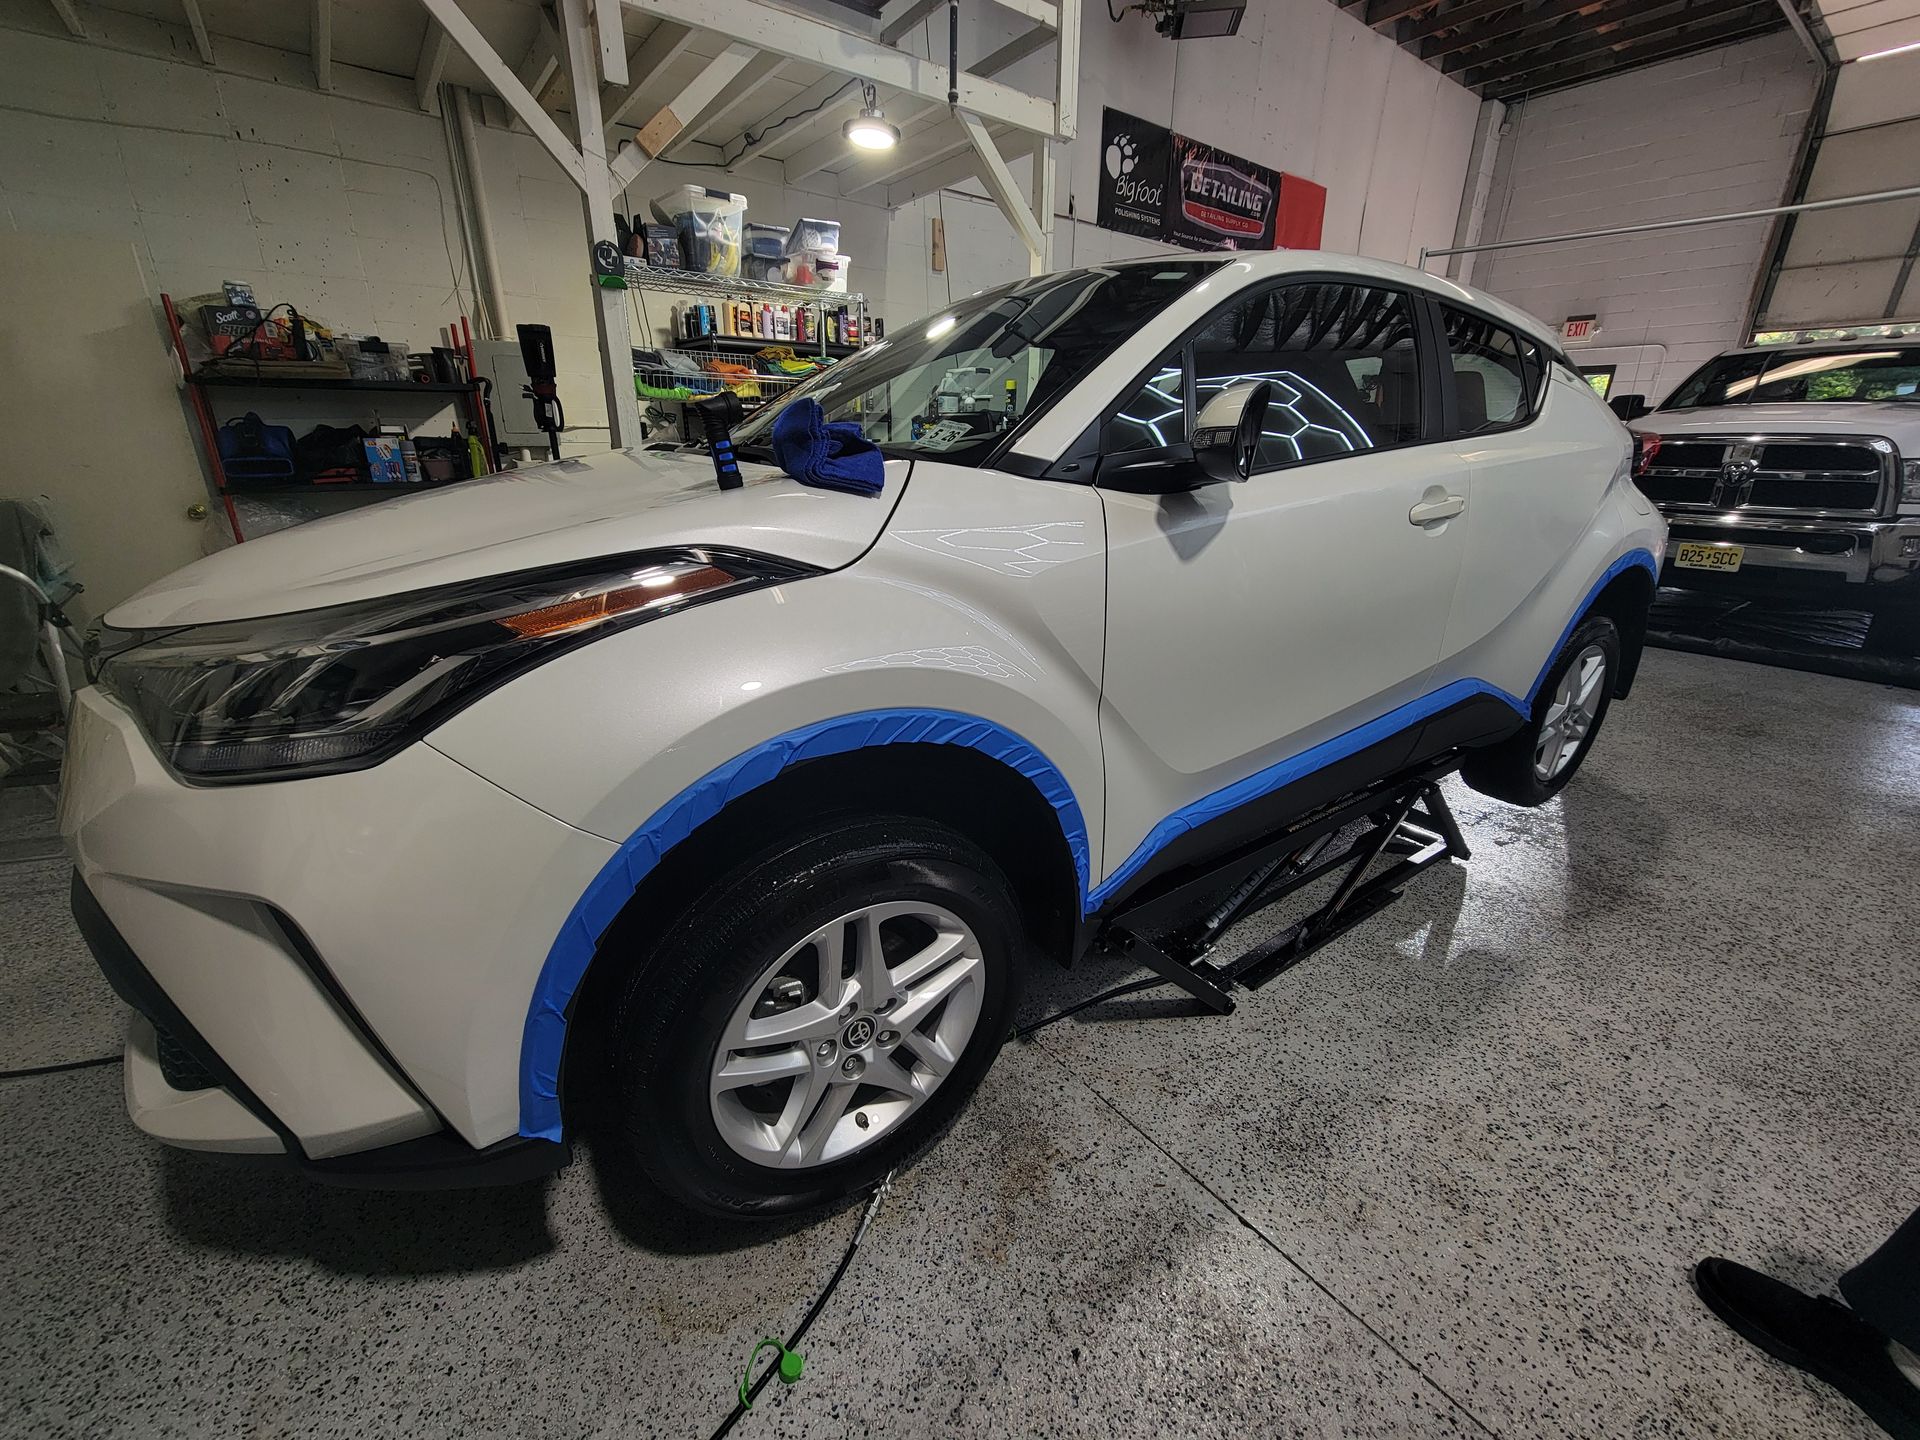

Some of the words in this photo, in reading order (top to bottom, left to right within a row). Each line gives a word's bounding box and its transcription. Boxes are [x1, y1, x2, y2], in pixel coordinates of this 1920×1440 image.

[1190, 170, 1263, 212] DETAILING
[1114, 207, 1140, 220] POLISHING
[1141, 214, 1161, 226] SYSTEMS
[1201, 211, 1225, 222] DETAILING
[1225, 216, 1241, 227] SUPPLY
[215, 310, 239, 324] Scott
[1567, 321, 1590, 337] EXIT
[929, 429, 944, 440] 5
[940, 430, 961, 443] 26
